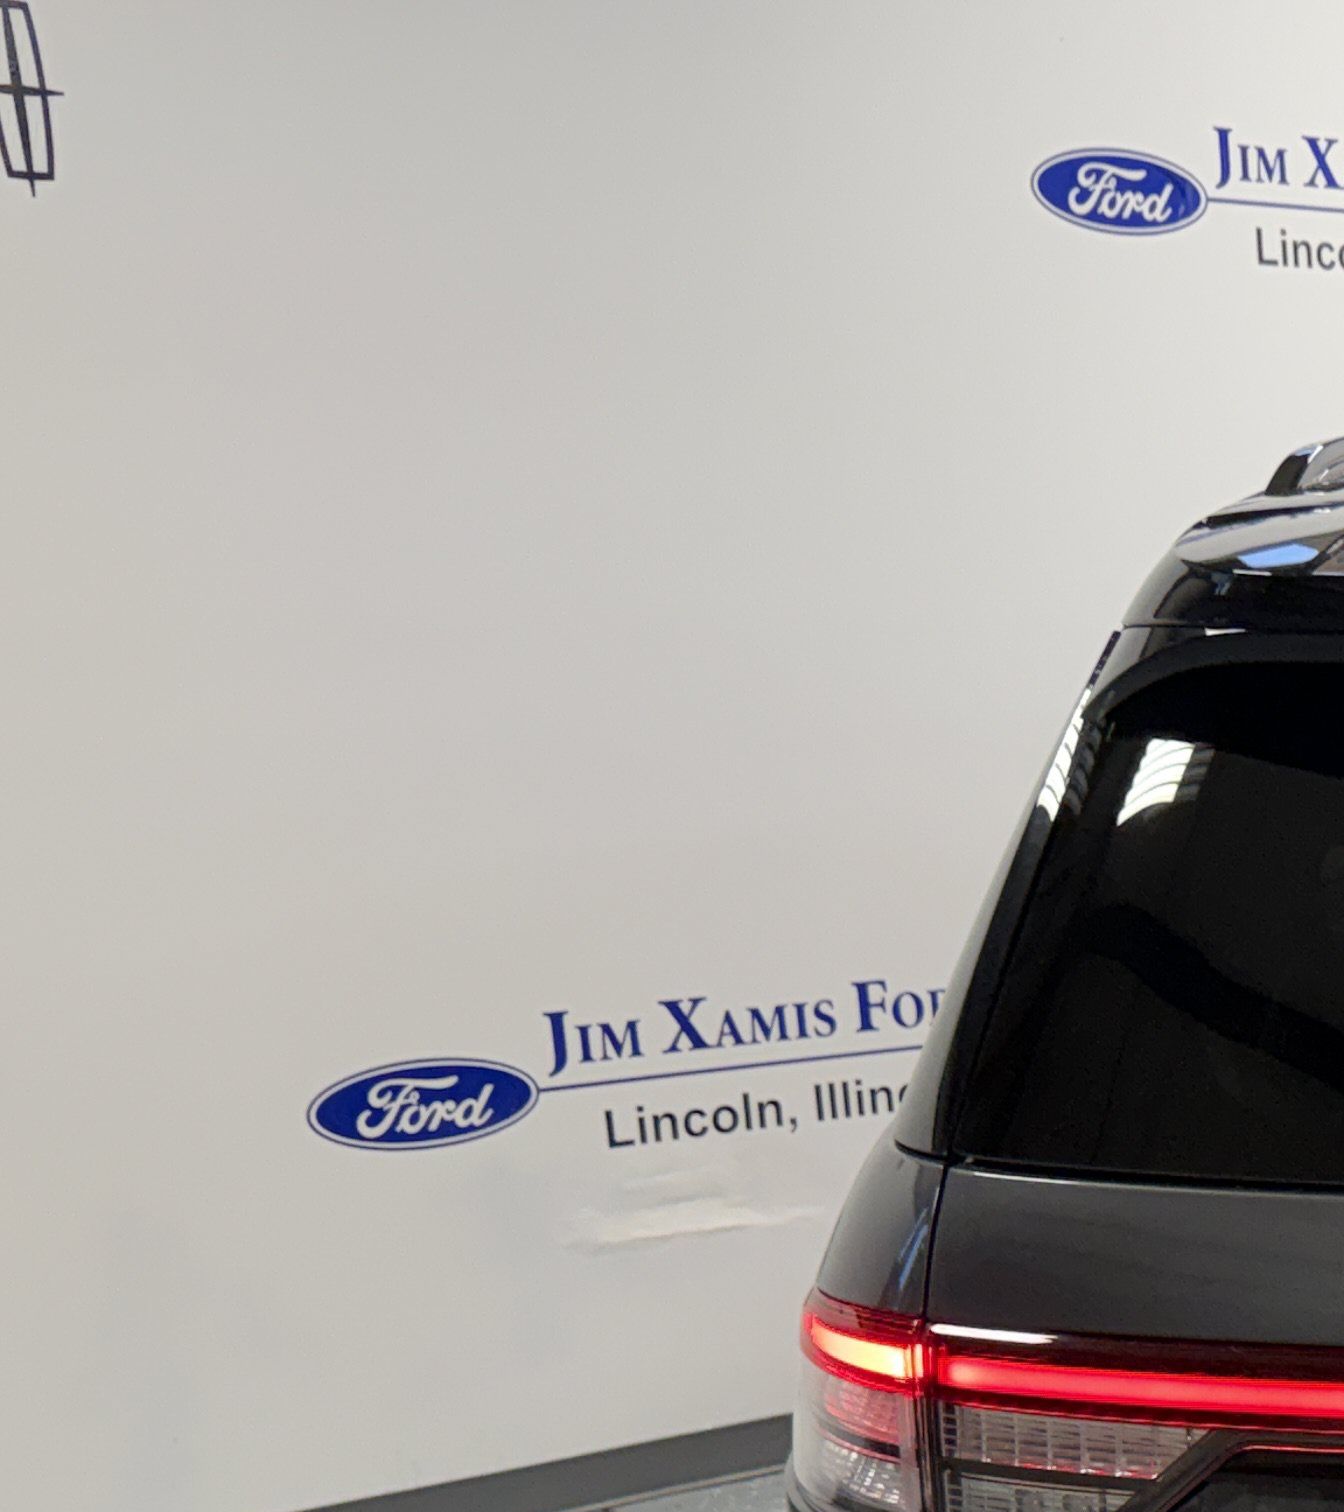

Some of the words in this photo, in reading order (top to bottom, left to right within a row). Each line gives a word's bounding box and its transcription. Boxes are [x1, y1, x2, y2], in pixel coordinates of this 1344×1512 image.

[1213, 126, 1290, 188] JIM
[1067, 160, 1172, 223] Ford
[542, 1009, 645, 1078] JIM
[657, 996, 838, 1056] XAMIS
[850, 979, 946, 1032] FO
[355, 1074, 495, 1139] Ford
[604, 1090, 800, 1150] Lincoln,
[812, 1078, 909, 1123] Illin
